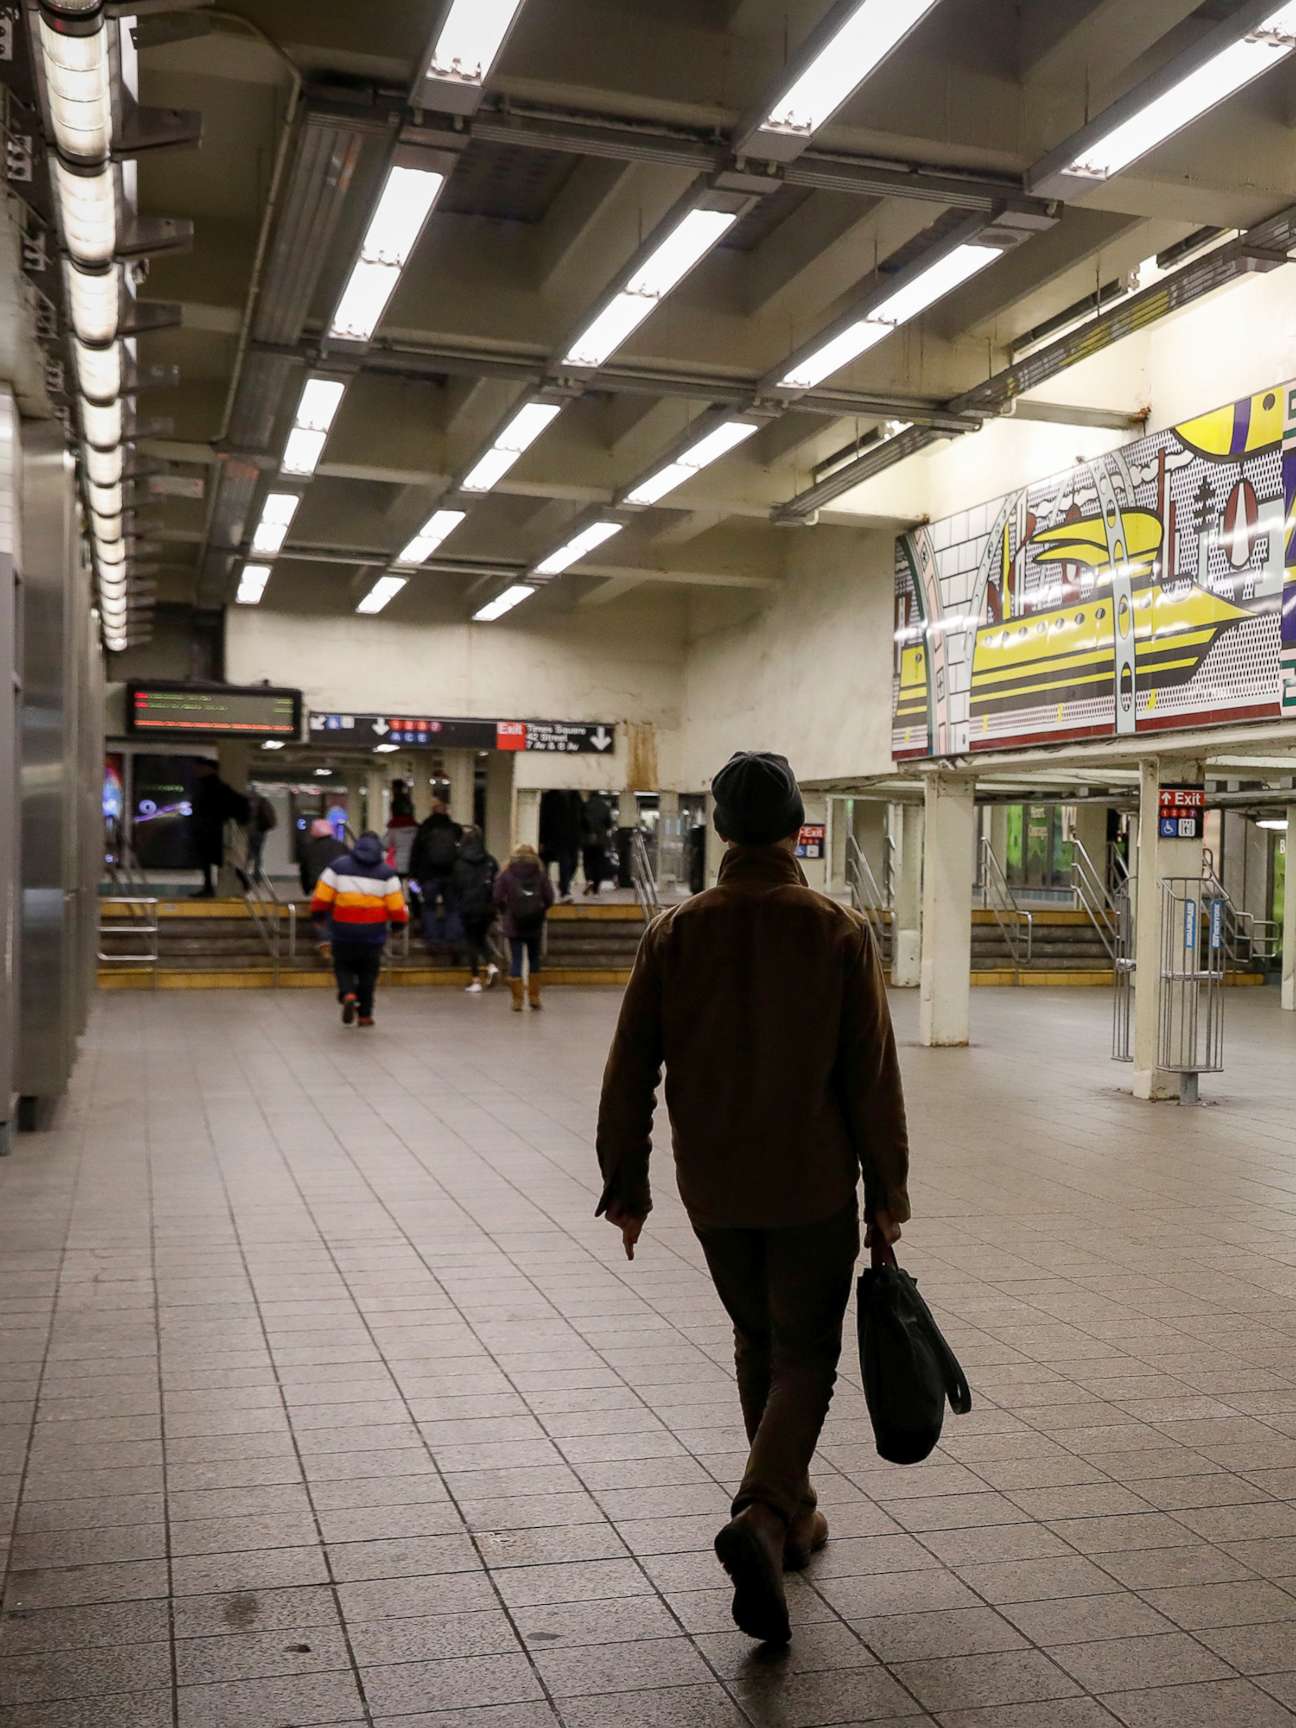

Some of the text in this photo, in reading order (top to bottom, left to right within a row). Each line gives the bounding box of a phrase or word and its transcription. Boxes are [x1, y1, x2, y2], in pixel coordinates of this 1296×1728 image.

[497, 721, 523, 735] Exit
[527, 723, 587, 735] Times Square
[527, 733, 568, 742] 42 Street
[1175, 791, 1201, 805] Exit
